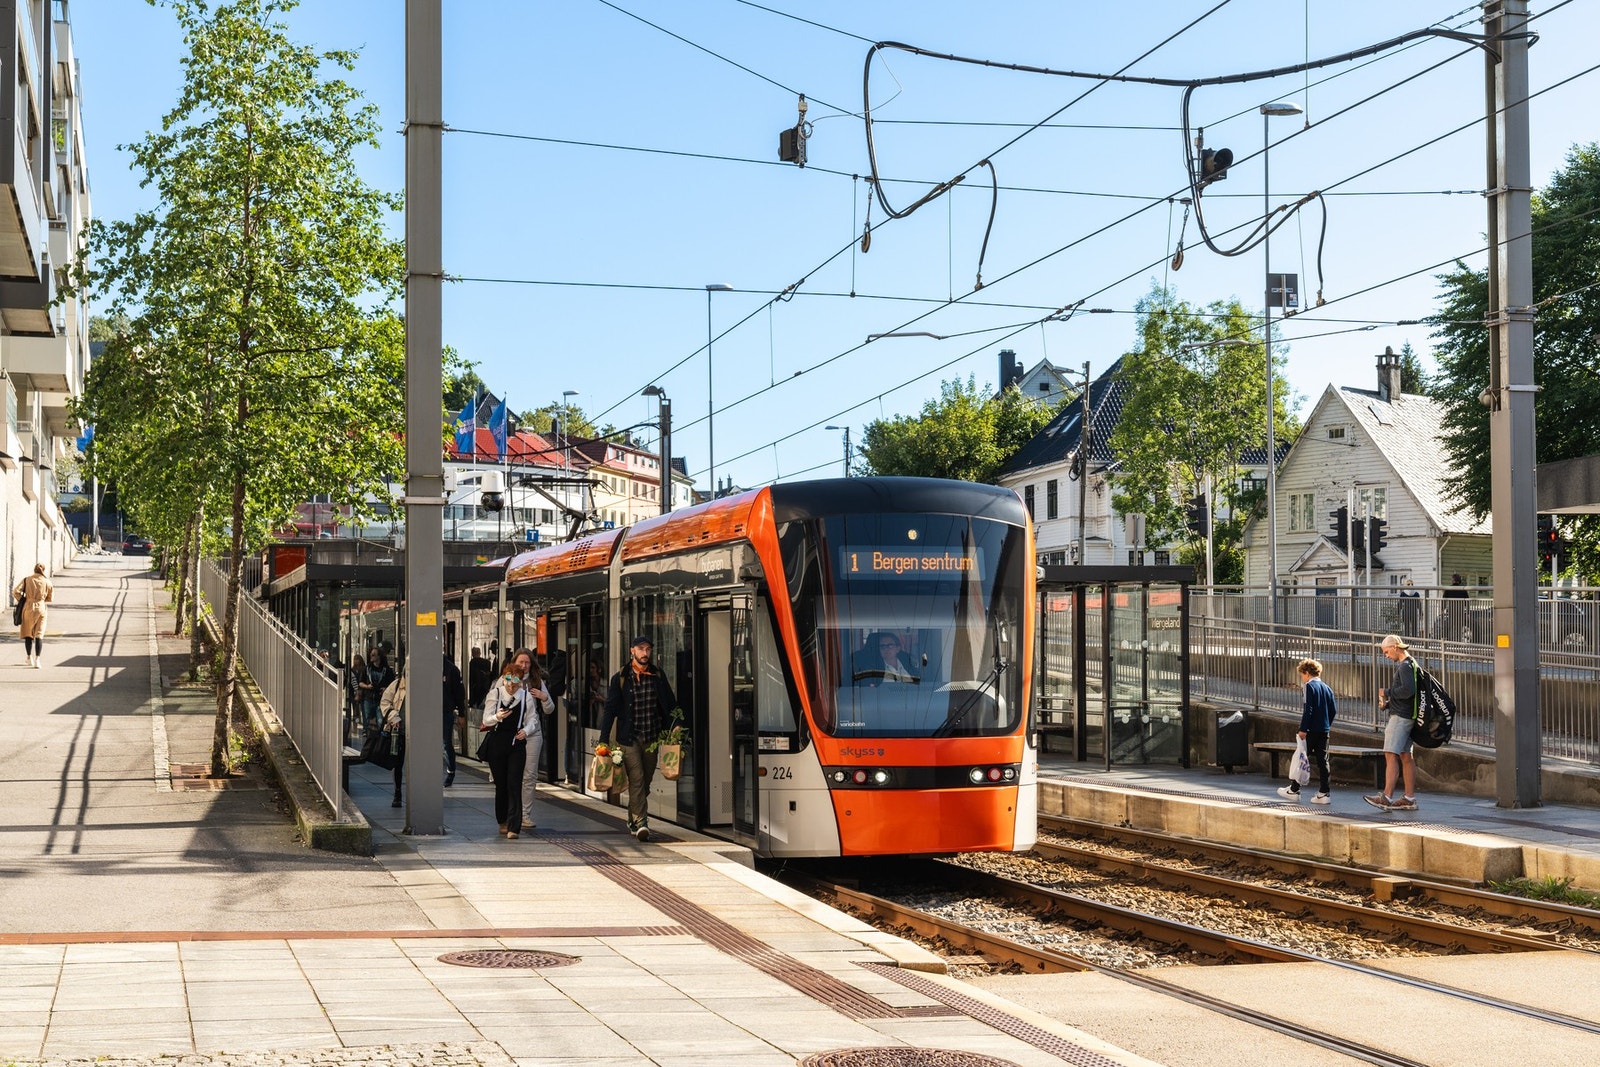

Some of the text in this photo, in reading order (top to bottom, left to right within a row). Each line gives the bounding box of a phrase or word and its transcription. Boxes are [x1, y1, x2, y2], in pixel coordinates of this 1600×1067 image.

[851, 552, 973, 574] 1 Bergen sentrum
[1418, 690, 1427, 719] unisport
[840, 747, 875, 758] skyss
[773, 767, 793, 780] 224
